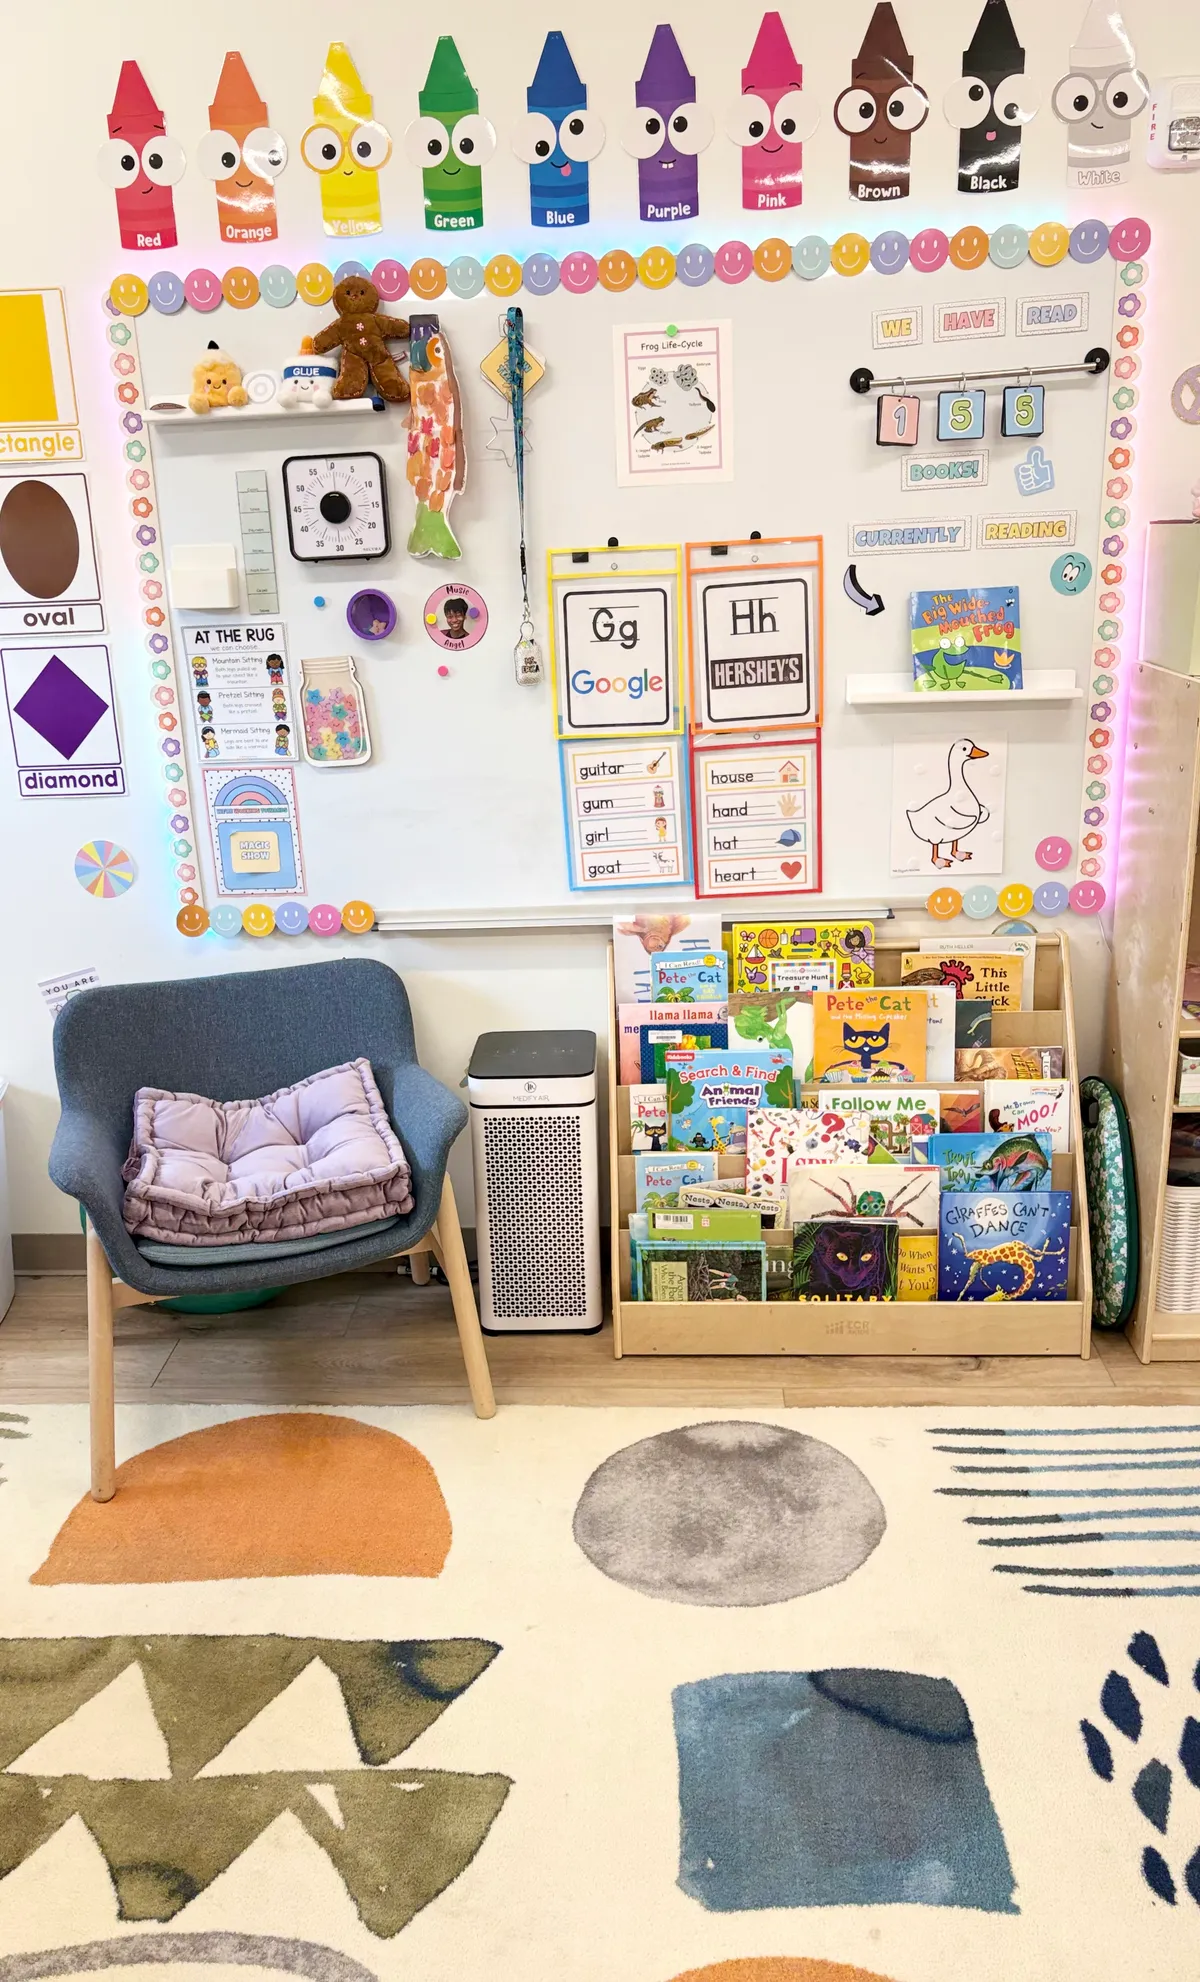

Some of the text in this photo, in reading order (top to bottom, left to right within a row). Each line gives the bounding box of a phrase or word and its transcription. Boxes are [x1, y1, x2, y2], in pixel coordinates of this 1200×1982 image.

[1149, 103, 1157, 141] FIRE
[970, 175, 1008, 190] Black
[1077, 168, 1121, 186] White
[858, 184, 901, 199] Brown
[757, 193, 787, 208] Pink
[546, 210, 575, 225] Blue
[647, 203, 691, 220] Purple
[434, 214, 475, 228] Green
[137, 233, 161, 247] Red
[226, 225, 273, 242] Orange
[881, 303, 1078, 338] WE HAVE READ
[640, 339, 703, 353] Frog Life-Cycle
[292, 367, 320, 377] GLUE
[893, 394, 1035, 437] 1 5 5
[308, 469, 318, 477] 55
[350, 466, 355, 474] 5
[909, 459, 980, 482] BOOKS!
[296, 485, 305, 493] 50
[364, 480, 373, 489] 10
[293, 506, 302, 514] 45
[371, 501, 380, 509] 15
[300, 525, 309, 533] 40
[367, 521, 377, 530] 20
[855, 520, 1067, 547] CURRENTLY READING
[315, 540, 325, 548] 35
[335, 544, 345, 552] 30
[354, 538, 364, 546] 25
[445, 585, 470, 596] Music
[931, 593, 953, 606] The
[731, 598, 777, 635] Hh
[921, 594, 991, 625] Big Wide-
[23, 607, 75, 628] oval
[938, 605, 1006, 636] Mouthed
[194, 627, 275, 644] AT THE RUG
[592, 608, 638, 650] Gg
[972, 620, 1015, 643] Frog
[443, 639, 465, 650] Angel
[241, 656, 263, 664] Sitting
[714, 656, 800, 688] HERSHEY'S
[571, 668, 663, 700] Google
[218, 691, 265, 699] Pretzel Sitting
[250, 727, 271, 735] Sitting
[579, 762, 625, 780] guitar
[711, 770, 754, 785] house
[24, 770, 118, 790] diamond
[582, 798, 614, 813] gum
[712, 801, 748, 818] hand
[585, 827, 610, 846] girl
[713, 836, 739, 851] hat
[239, 841, 271, 850] MAGIC
[241, 851, 270, 861] SHOW
[587, 860, 622, 878] goat
[714, 868, 757, 883] heart
[658, 970, 687, 984] Pete
[697, 971, 722, 983] Cat
[980, 968, 1008, 978] This
[45, 975, 96, 995] YOU ARE
[975, 981, 1010, 992] Little
[826, 995, 912, 1012] Pete the Cat
[649, 1009, 714, 1021] llama llama
[855, 1012, 877, 1022] Missing
[878, 1013, 908, 1021] Cupcakes
[679, 1064, 777, 1083] Search & Find
[708, 1096, 757, 1106] Friends
[832, 1097, 891, 1110] Follow
[897, 1097, 927, 1110] Me
[1013, 1099, 1036, 1109] Brown
[637, 1105, 667, 1118] Pete
[1017, 1101, 1059, 1131] MOO!
[646, 1174, 704, 1187] Pete Cat
[945, 1202, 1050, 1225] GIRAFFES CAN'T
[969, 1220, 1029, 1238] DANCE
[909, 1250, 933, 1260] When
[900, 1263, 926, 1274] Wants
[908, 1277, 936, 1291] You?
